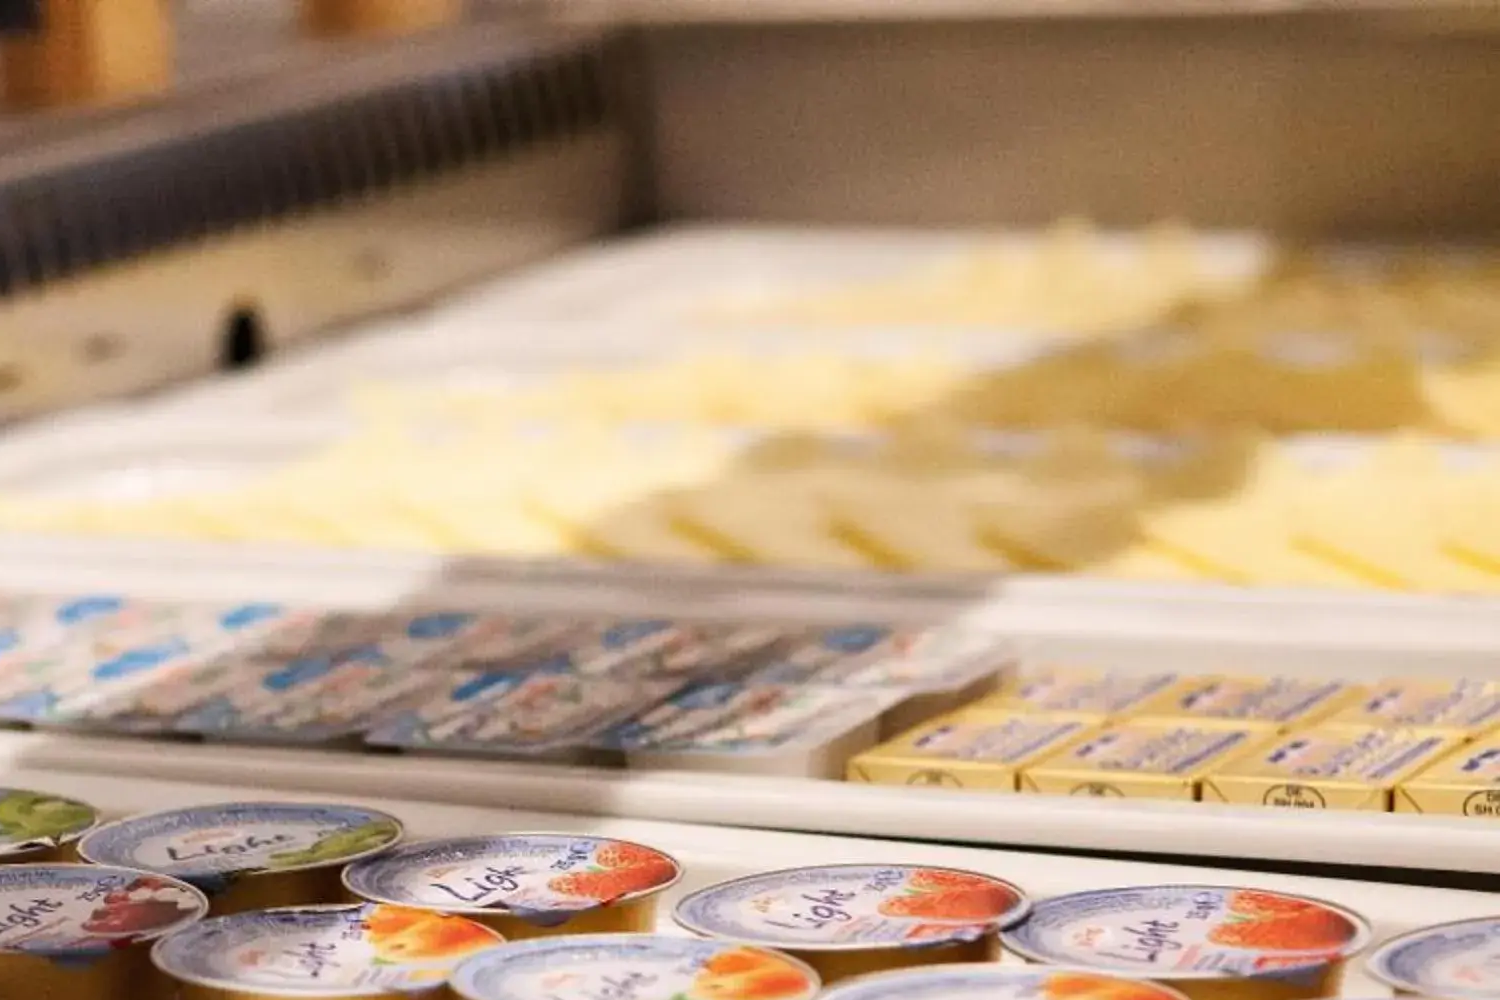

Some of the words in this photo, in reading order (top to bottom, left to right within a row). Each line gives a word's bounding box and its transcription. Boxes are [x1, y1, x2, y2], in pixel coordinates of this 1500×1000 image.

[430, 866, 526, 901] Ligh
[765, 889, 856, 929] Light
[1097, 920, 1183, 963] Light
